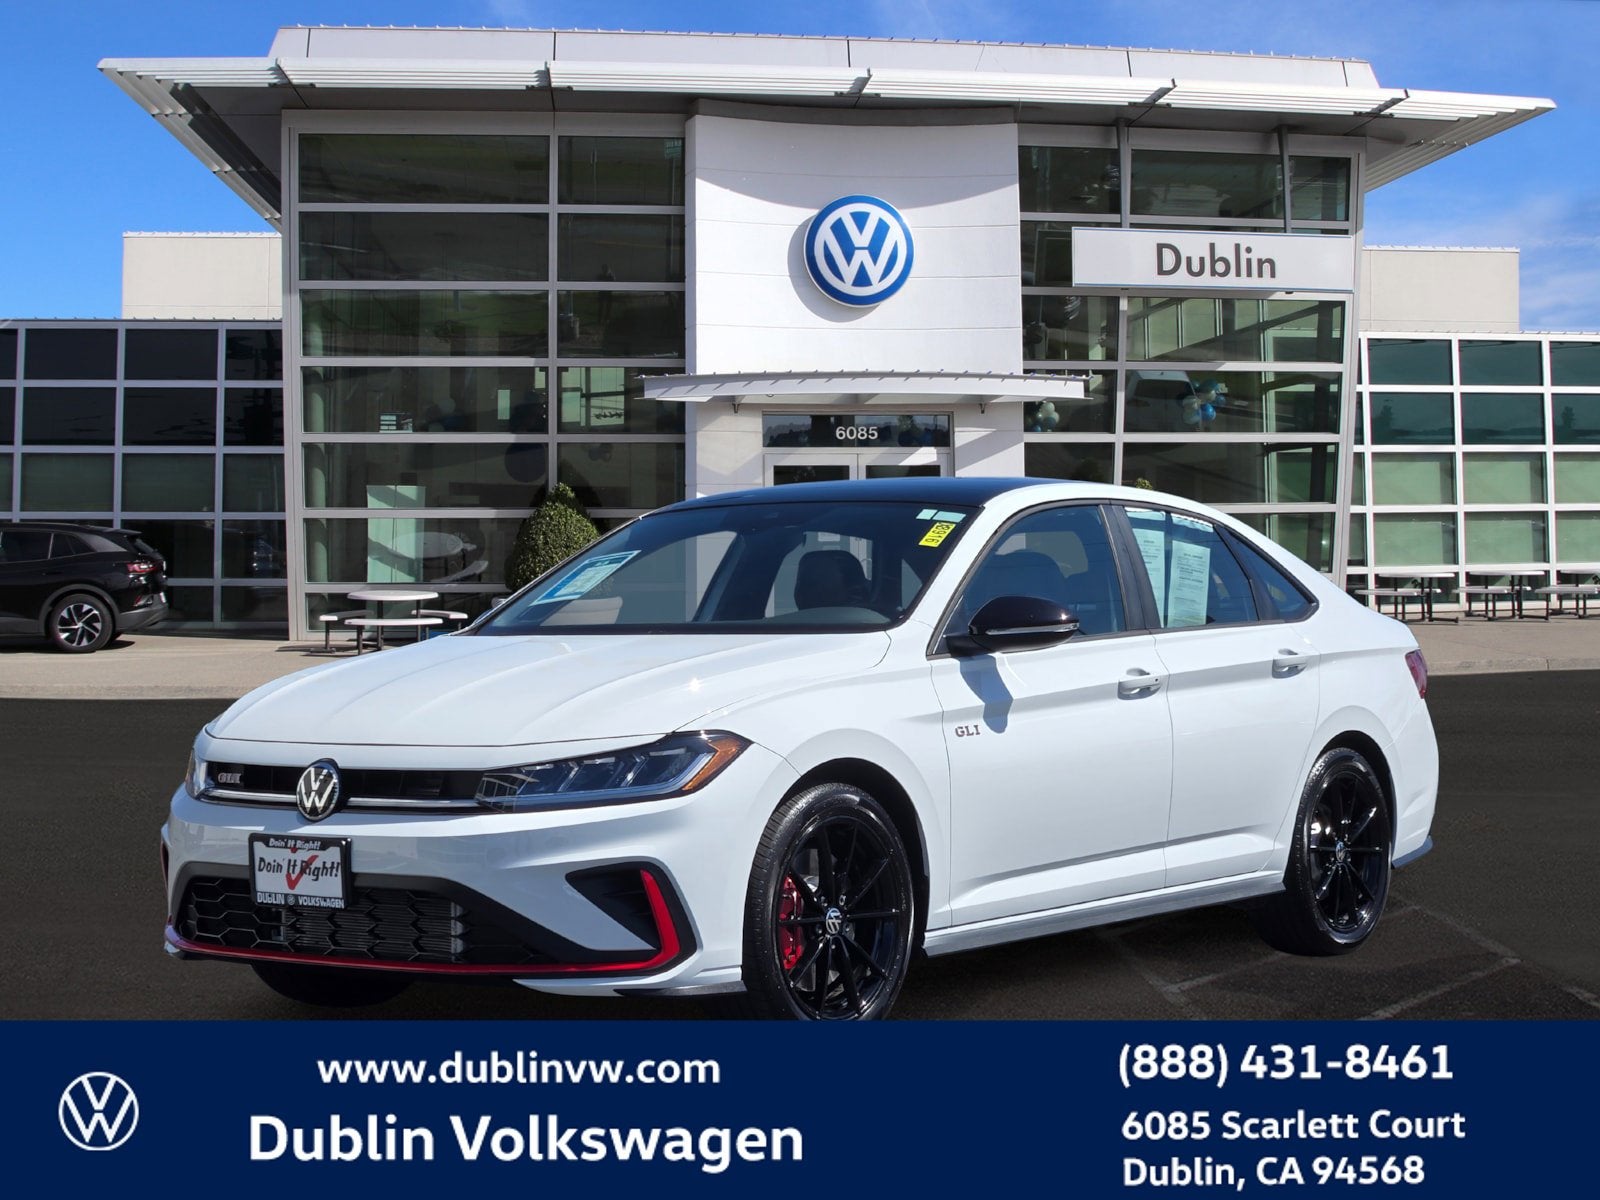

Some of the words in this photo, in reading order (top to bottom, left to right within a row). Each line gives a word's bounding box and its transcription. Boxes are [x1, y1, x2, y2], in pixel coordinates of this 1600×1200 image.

[1156, 243, 1277, 280] Dublin
[835, 426, 879, 440] 6085
[955, 724, 981, 738] GLI
[269, 838, 287, 847] Doin'
[287, 839, 296, 847] It
[296, 840, 321, 851] Right!
[257, 857, 286, 874] Doin'
[287, 858, 298, 874] It
[299, 860, 341, 882] Right!
[298, 896, 345, 909] VOLKSWAGEN
